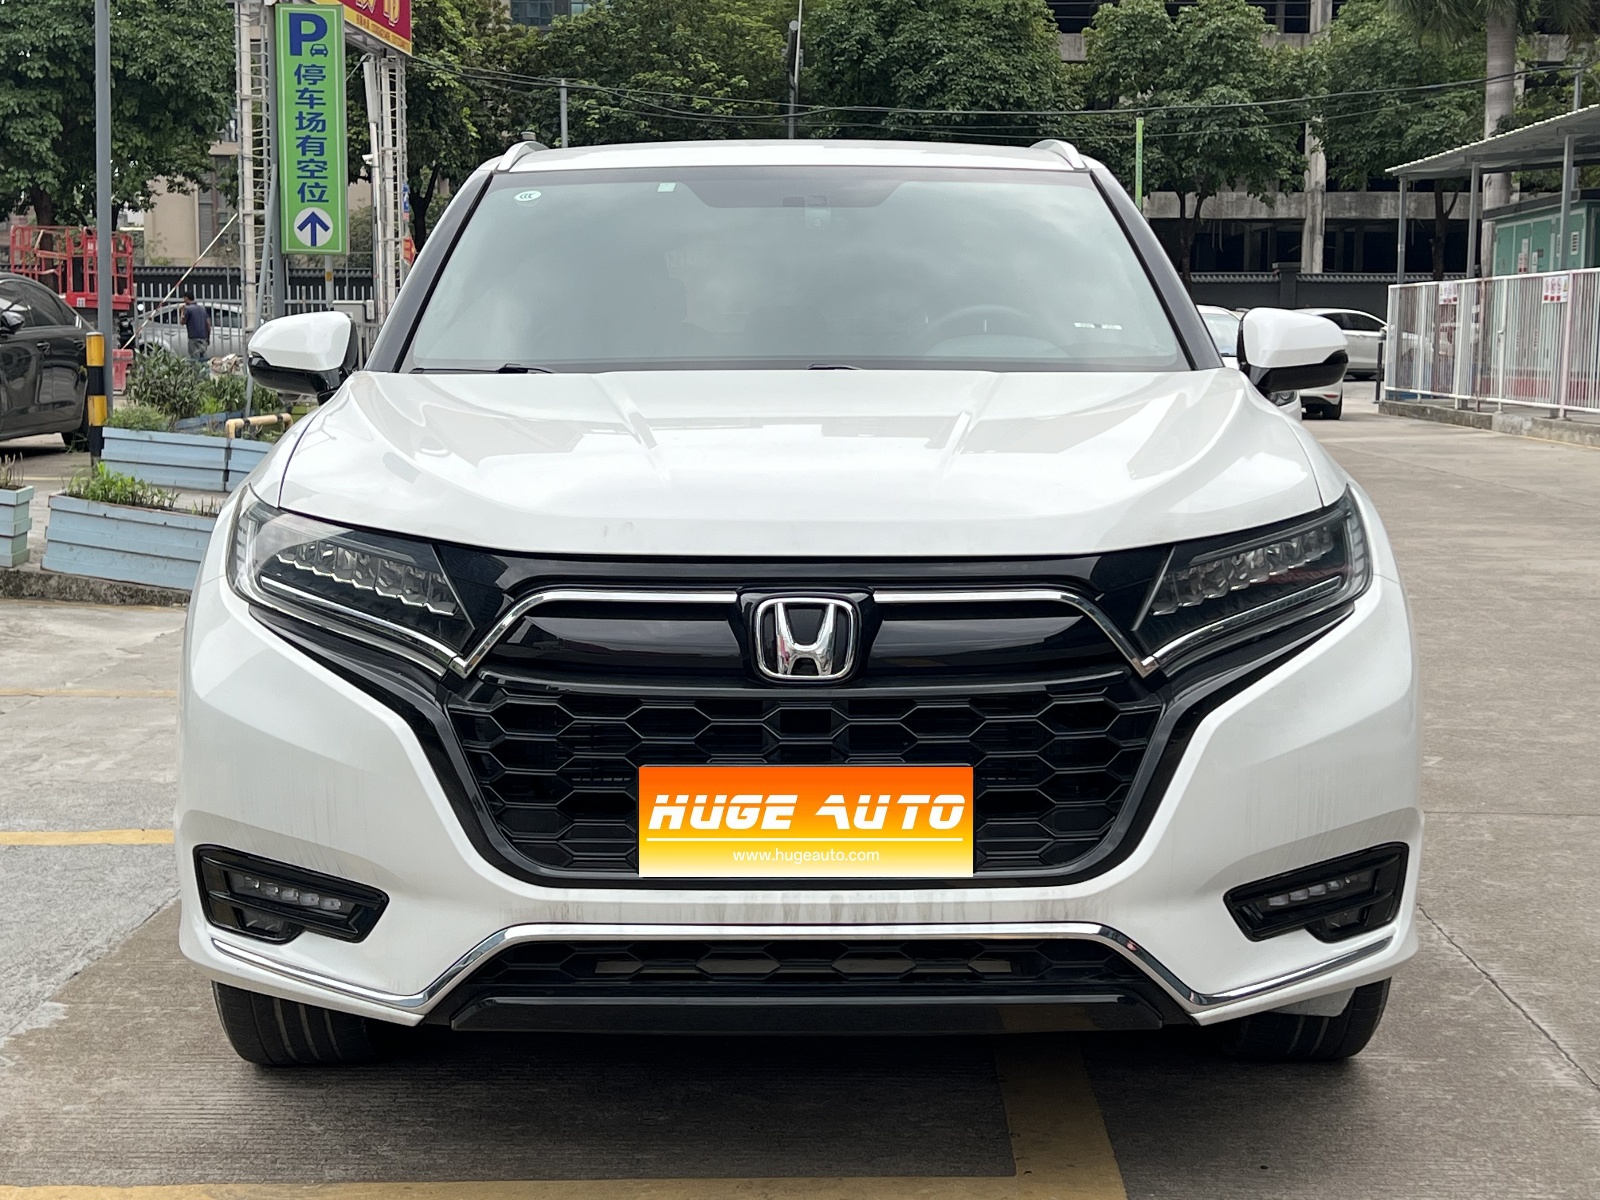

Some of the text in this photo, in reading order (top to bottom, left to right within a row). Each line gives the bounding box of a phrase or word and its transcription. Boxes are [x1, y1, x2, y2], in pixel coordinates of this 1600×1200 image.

[289, 13, 328, 56] P
[293, 63, 330, 204] 停车场有空位
